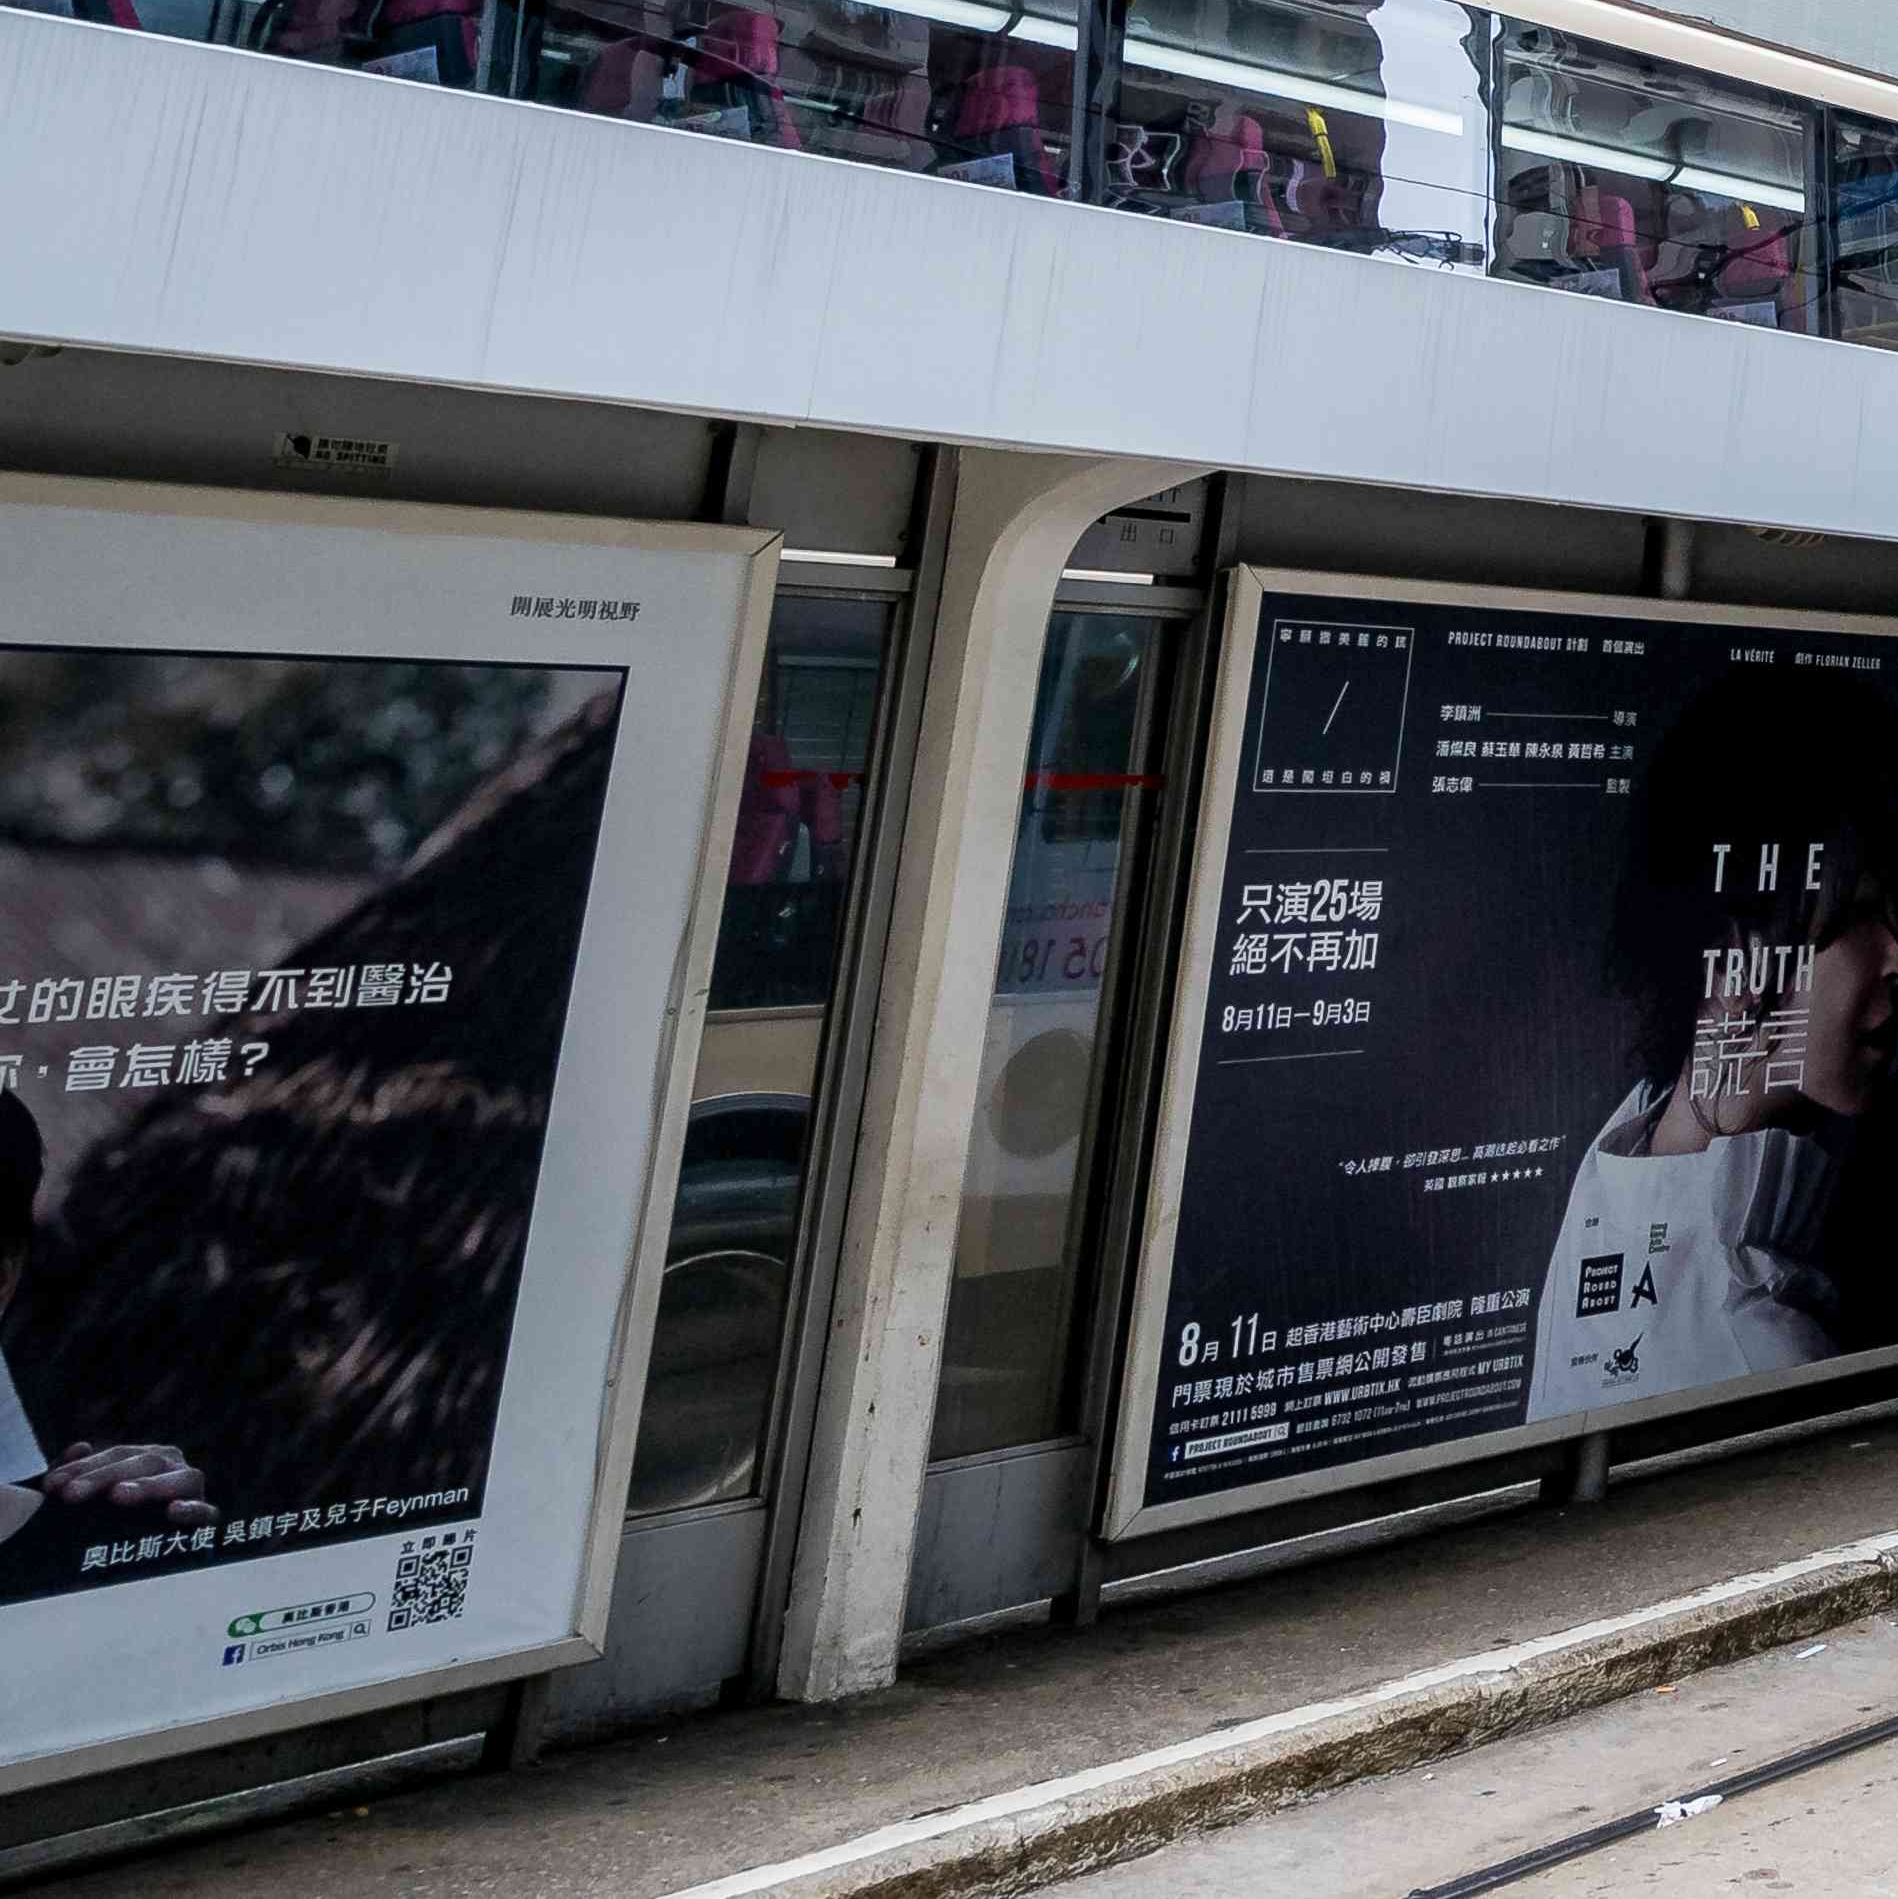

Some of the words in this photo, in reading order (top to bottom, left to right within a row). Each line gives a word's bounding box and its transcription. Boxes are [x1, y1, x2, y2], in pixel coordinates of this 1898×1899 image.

[509, 595, 641, 622] 開展光明視野
[1447, 630, 1493, 648] PROJECT
[1496, 633, 1563, 651] ROUNDABOUT
[1730, 647, 1742, 662] LA
[1852, 655, 1881, 670] ZELLER
[1712, 843, 1825, 893] THE
[1236, 878, 1383, 925] 只演25場
[1229, 928, 1379, 976] 絕不再加
[1702, 944, 1816, 999] TRUTH
[1689, 1008, 1810, 1101] 謊言
[1172, 1341, 1428, 1409] 門票現於城市售票網公開發售
[1221, 1407, 1249, 1427] 2111
[1323, 1377, 1402, 1407] WWW.URBTIX.HK
[1477, 1360, 1492, 1376] MY
[1492, 1354, 1524, 1373] URBTIX
[256, 1640, 286, 1655] Orbis
